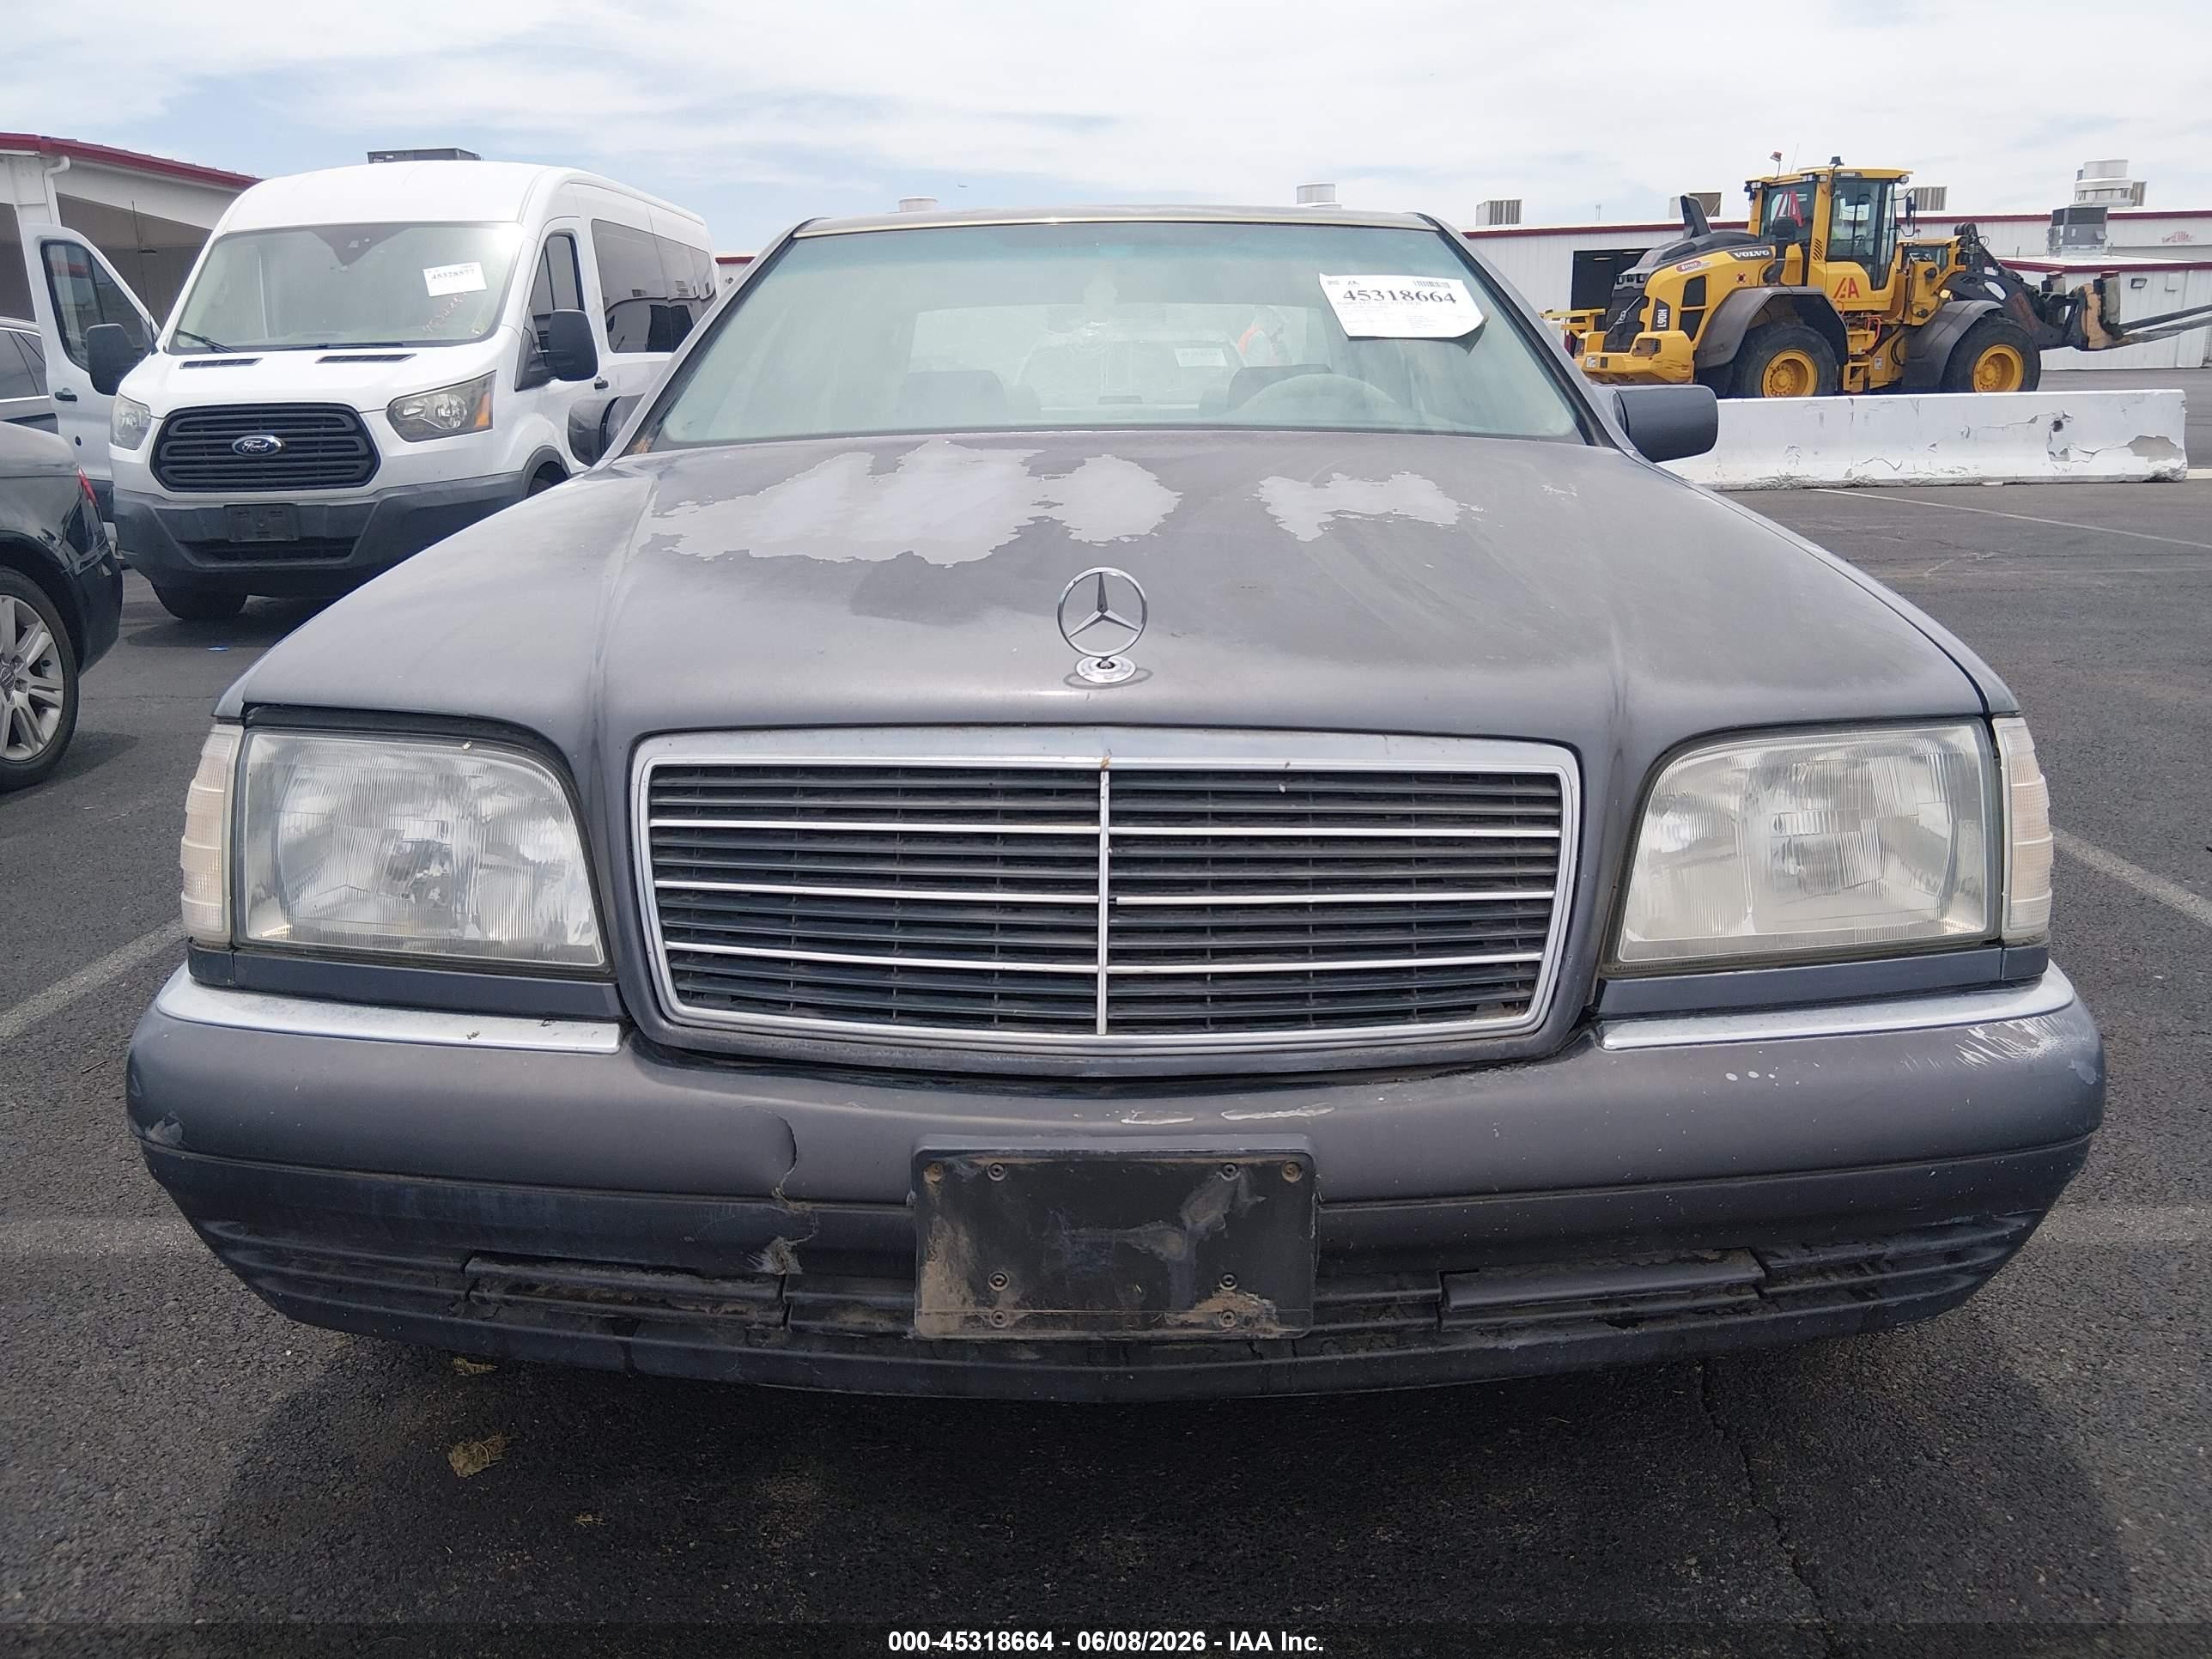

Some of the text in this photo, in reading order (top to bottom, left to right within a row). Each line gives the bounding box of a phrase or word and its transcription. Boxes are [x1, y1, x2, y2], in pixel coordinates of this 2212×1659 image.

[1733, 249, 1770, 258] VOLVO
[1343, 289, 1457, 304] 45318664
[1656, 308, 1668, 328] L90H
[242, 440, 269, 453] Ford
